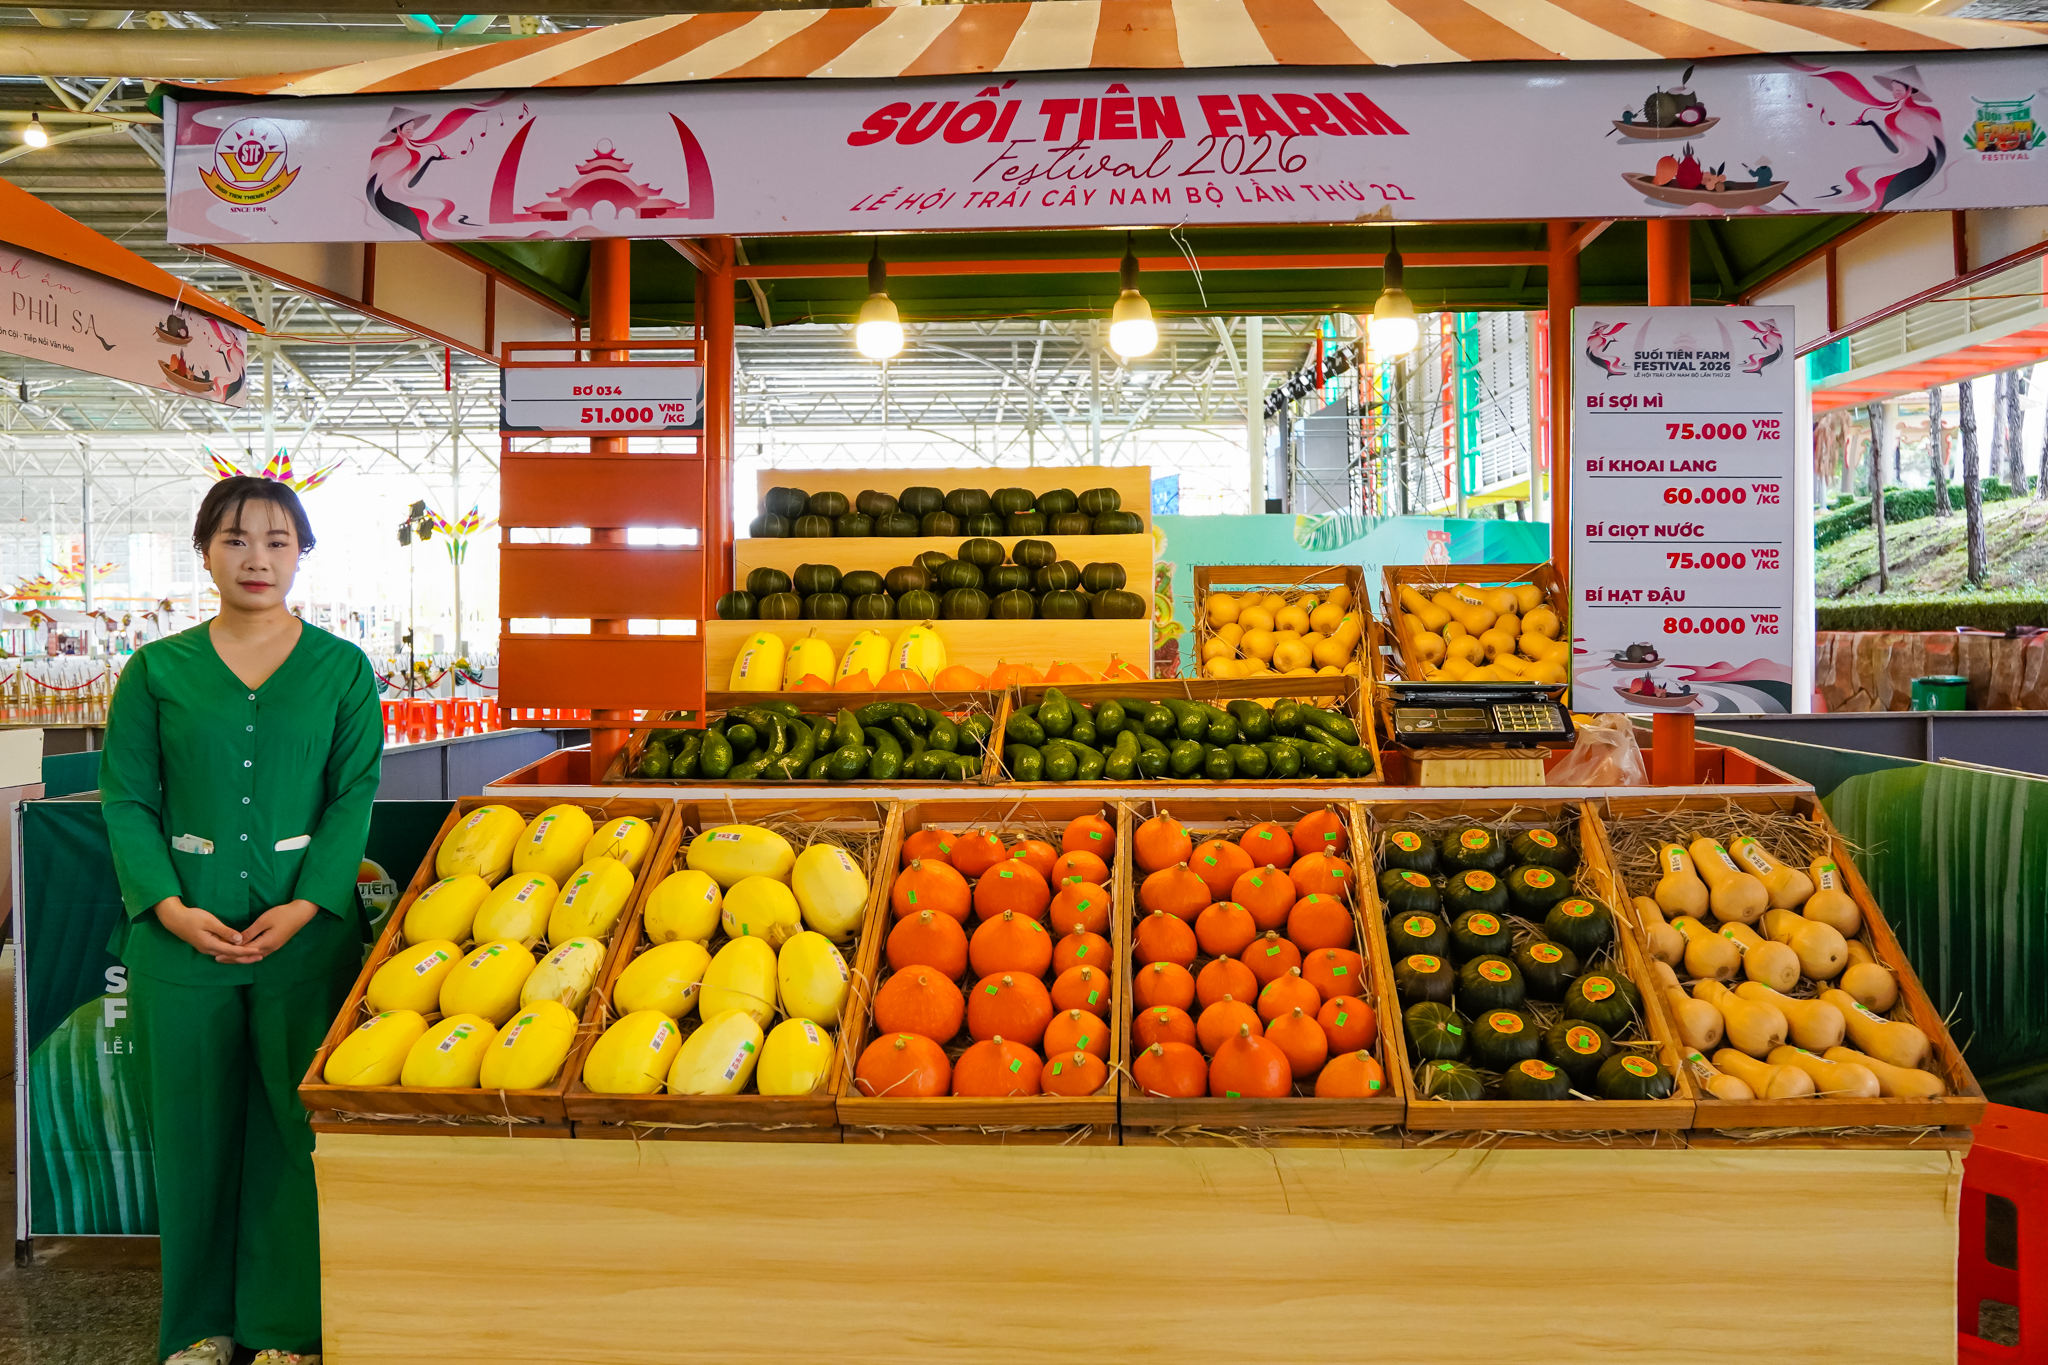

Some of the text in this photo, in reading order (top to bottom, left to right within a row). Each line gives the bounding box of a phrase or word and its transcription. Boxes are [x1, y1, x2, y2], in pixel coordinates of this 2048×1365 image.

[847, 79, 1410, 147] SUỐI TIÊN FARM
[241, 144, 261, 163] STF
[973, 133, 1307, 185] Festival 2026
[1982, 153, 2030, 161] FESTIVAL
[265, 184, 281, 195] PARK
[849, 179, 1416, 214] LỄ HỘI TRÁI CÂY NAM BỘ LẦN THỨ 22
[72, 309, 116, 351] SA
[1634, 348, 1730, 360] SUỐI TIÊN FARM
[1634, 361, 1731, 371] FESTIVAL 2026
[573, 385, 622, 396] BƠ 034
[658, 403, 685, 412] VND
[1586, 392, 1663, 411] BÍ SỢI MÌ
[580, 407, 654, 424] 51.000
[663, 414, 685, 424] /KG
[1752, 420, 1780, 428] VND
[1665, 423, 1747, 440] 75.000
[1757, 430, 1780, 441] /KG
[1586, 456, 1717, 472] BÍ KHOAI LANG
[1663, 487, 1747, 504] 60.000
[1751, 484, 1780, 493] VND
[1756, 495, 1780, 505] /KG
[1586, 521, 1705, 540] BÍ GIỌT NƯỚC
[1666, 552, 1746, 569] 75.000
[1751, 549, 1779, 558] VND
[1755, 560, 1779, 570] /KG
[1585, 586, 1686, 606] BÍ HẠT ĐẬU
[1750, 614, 1779, 623] VND
[1663, 617, 1746, 635] 80.000
[1755, 625, 1779, 635] /KG
[104, 1036, 123, 1054] LỄ
